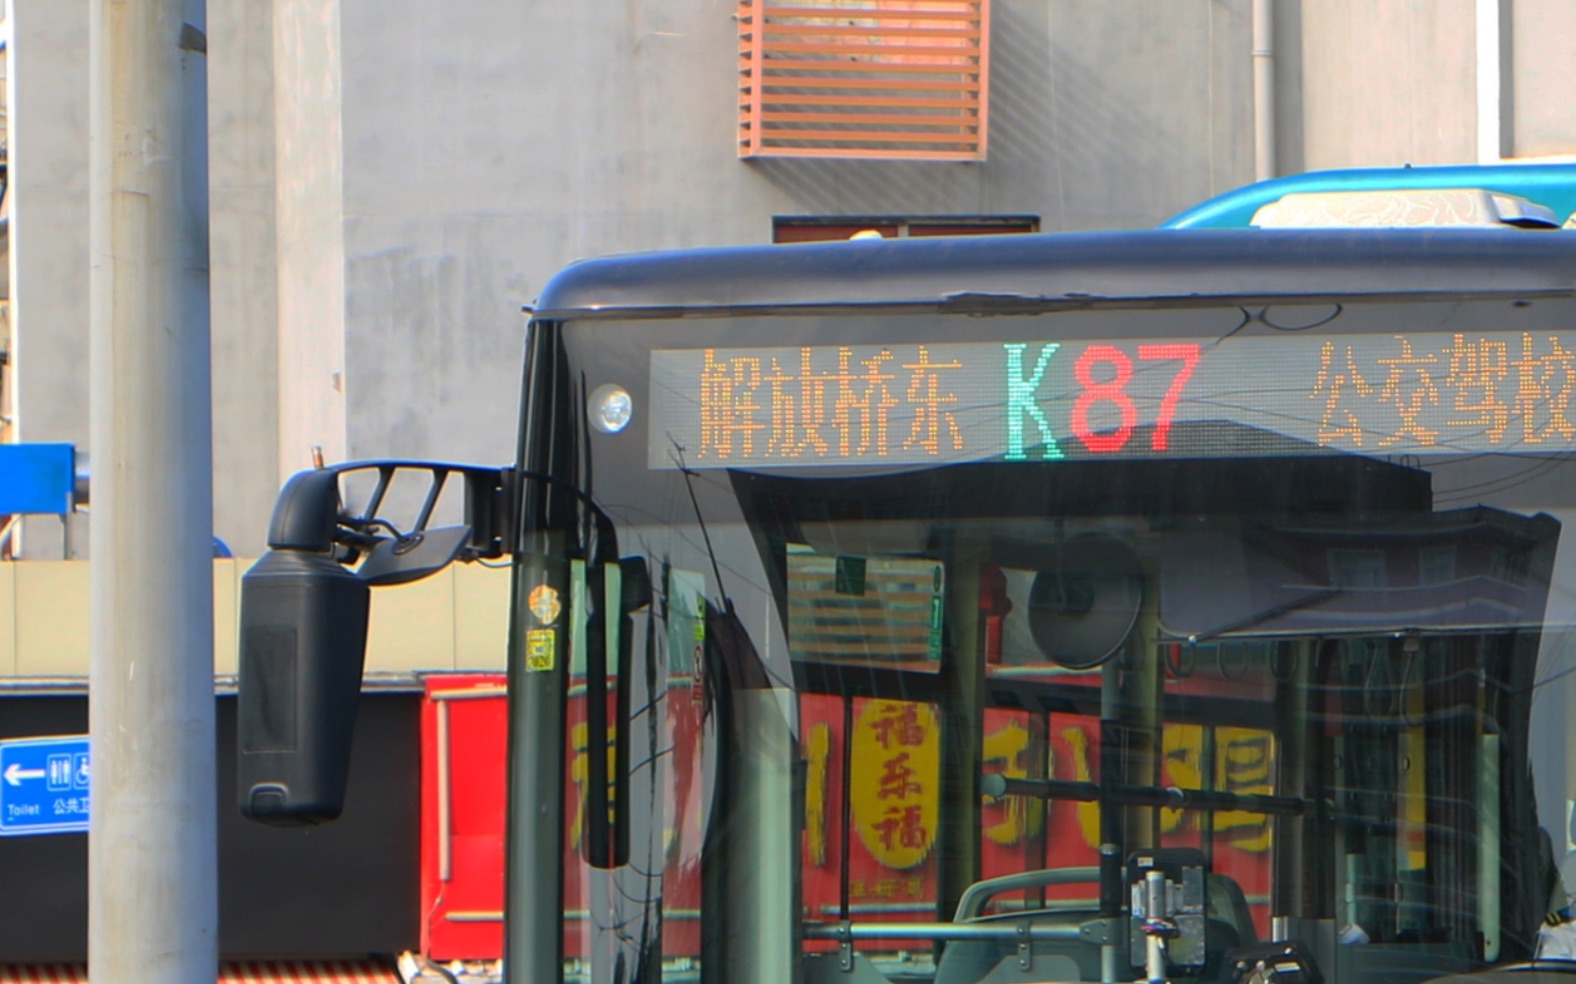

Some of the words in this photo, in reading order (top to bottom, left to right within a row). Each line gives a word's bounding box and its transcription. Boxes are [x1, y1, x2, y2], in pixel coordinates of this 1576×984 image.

[698, 346, 963, 458] 解放桥东
[1003, 342, 1200, 460] K87
[7, 803, 40, 817] Toilet
